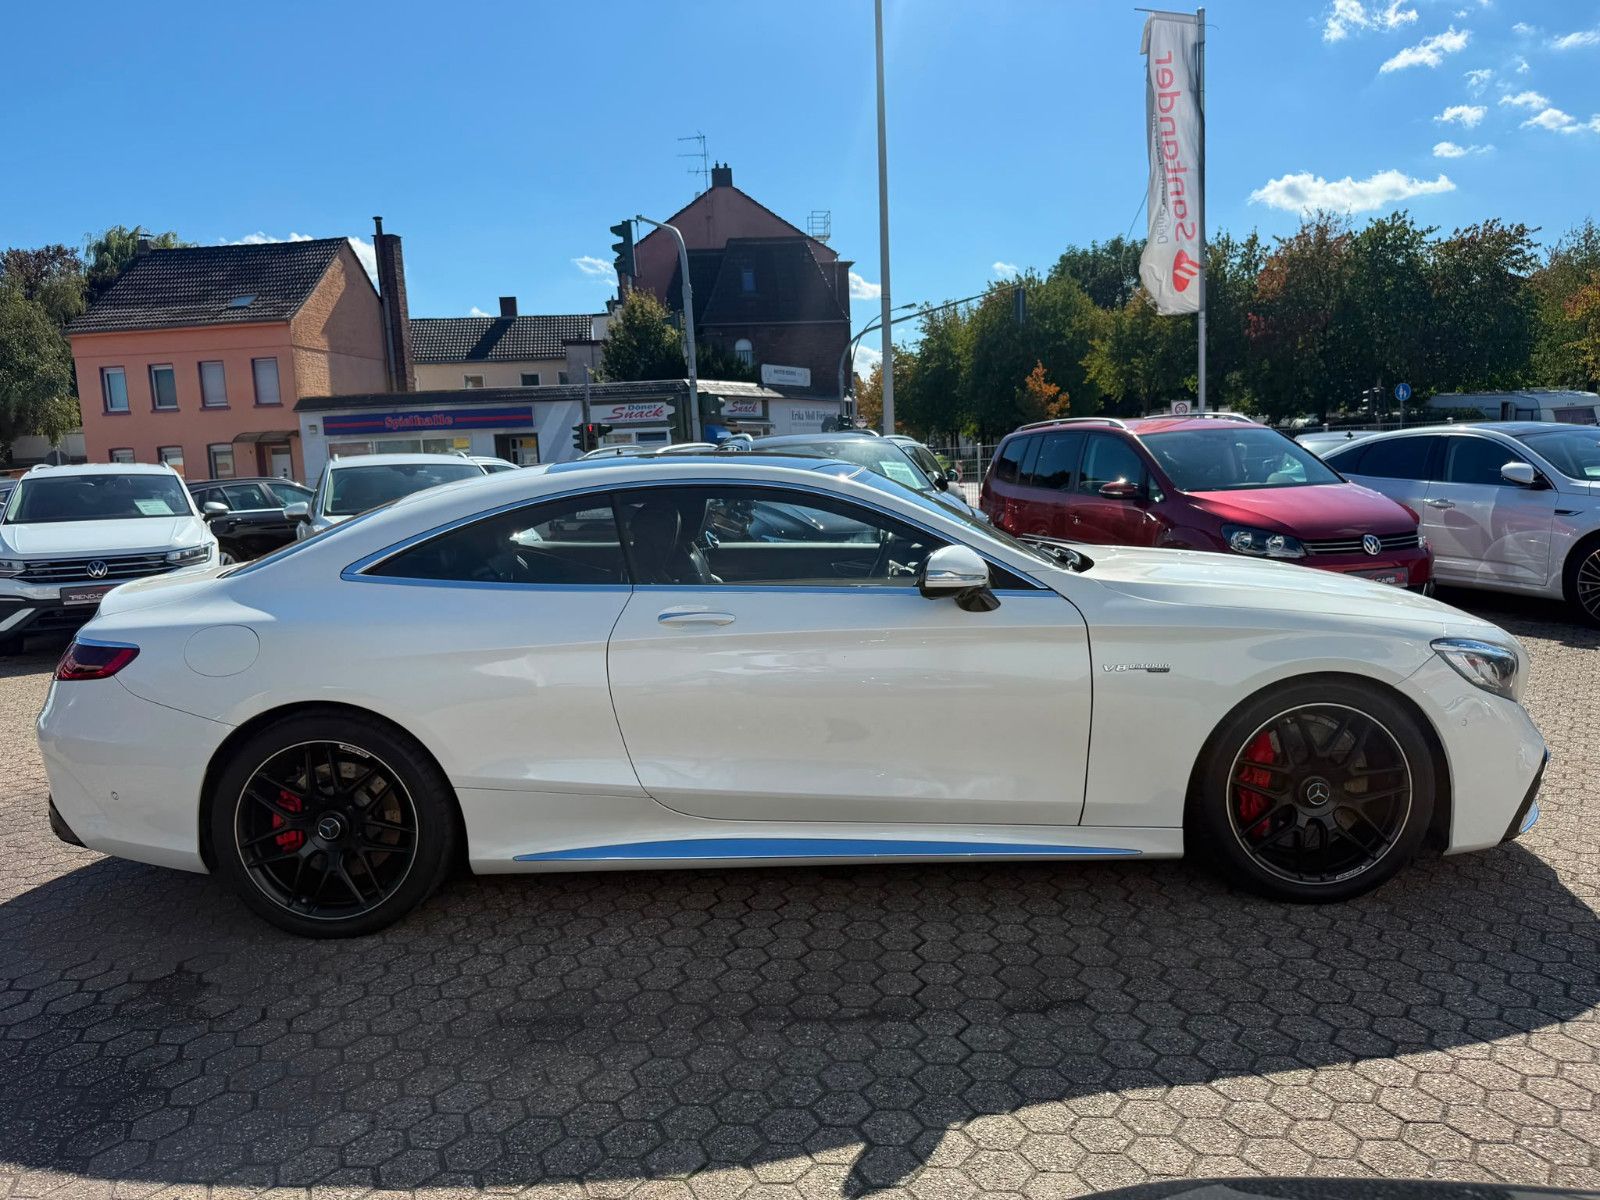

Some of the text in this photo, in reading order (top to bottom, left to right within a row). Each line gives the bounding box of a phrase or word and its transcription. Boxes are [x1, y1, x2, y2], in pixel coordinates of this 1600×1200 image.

[602, 405, 664, 420] Snack
[728, 401, 758, 412] Snack
[385, 414, 454, 430] Spielhalle
[1103, 664, 1127, 672] V8
